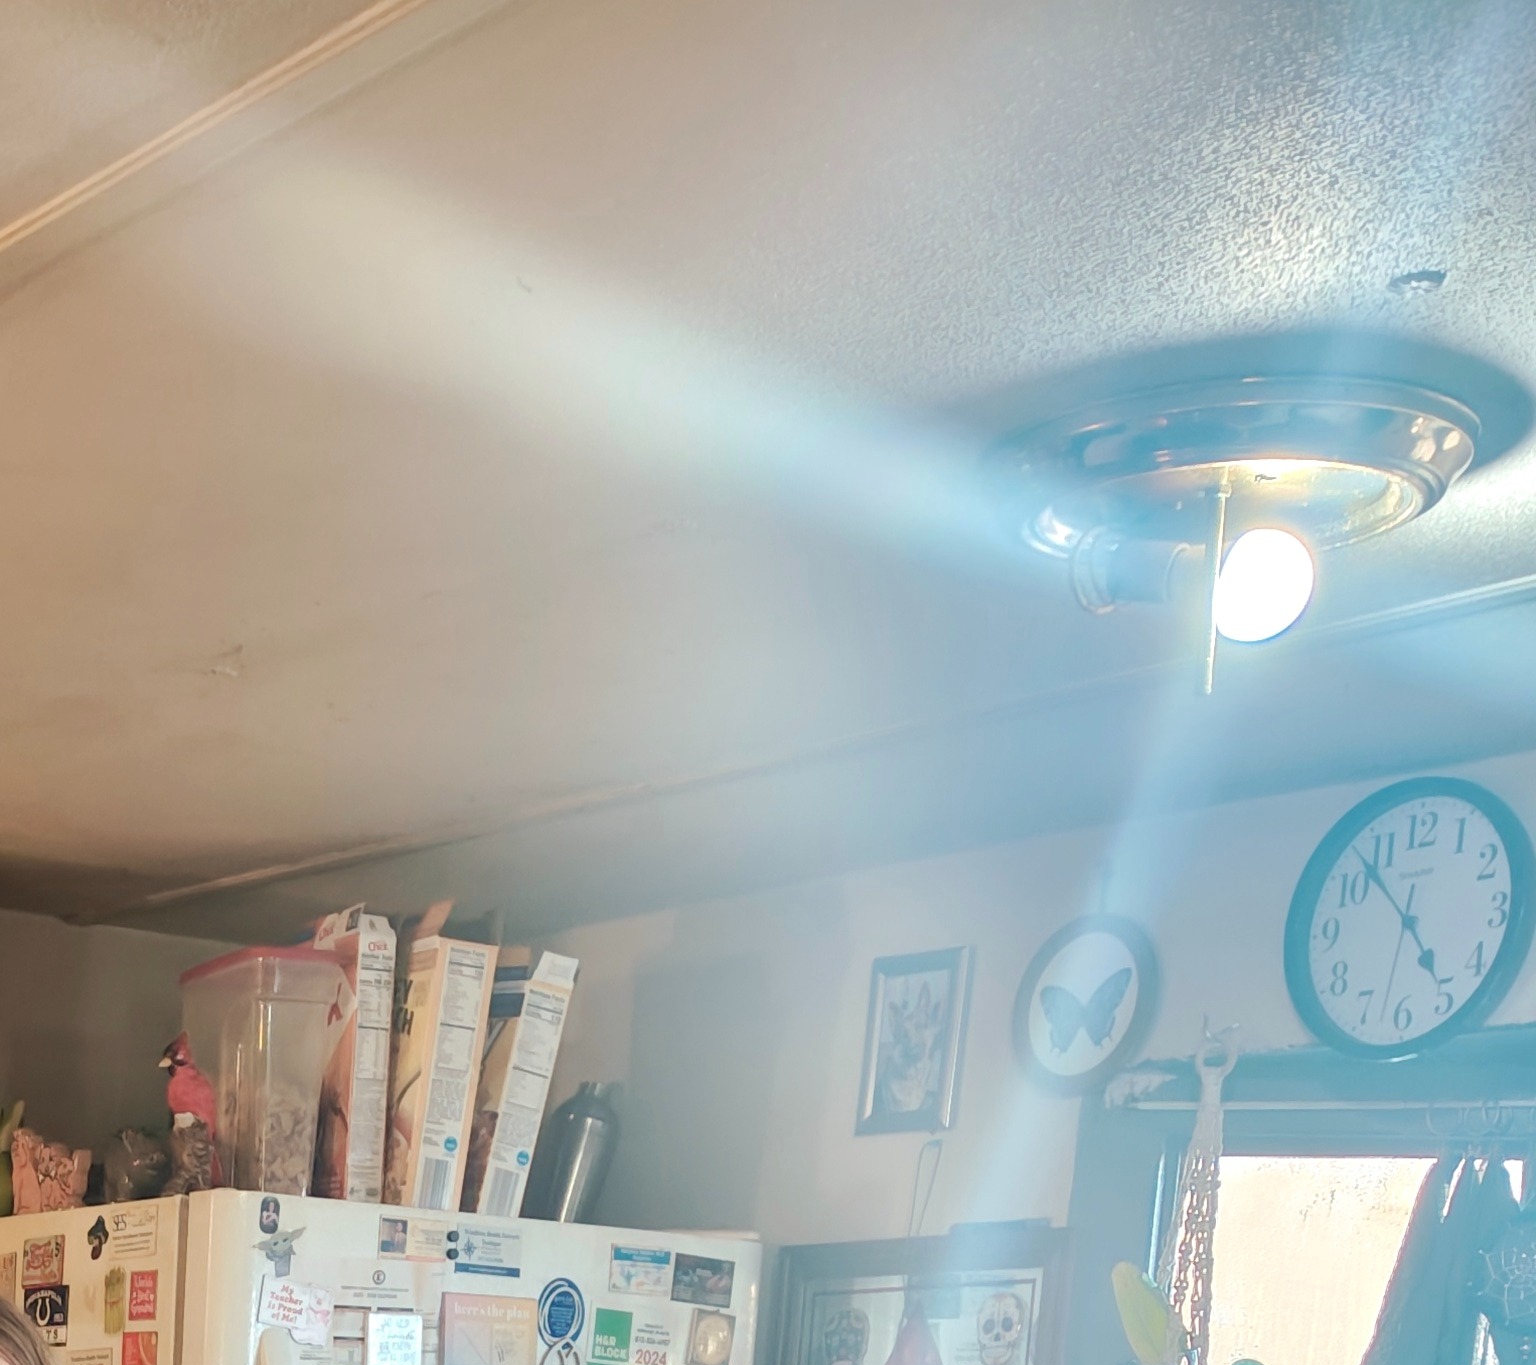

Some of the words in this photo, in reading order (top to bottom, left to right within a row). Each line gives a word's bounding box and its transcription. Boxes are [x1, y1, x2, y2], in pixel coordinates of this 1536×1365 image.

[1405, 811, 1439, 851] 12
[1453, 817, 1467, 855] 1
[1371, 832, 1396, 872] 11
[1476, 843, 1499, 881] 2
[1337, 870, 1370, 909] 10
[1487, 890, 1509, 929] 3
[1321, 917, 1341, 953] 9
[1464, 940, 1487, 978] 4
[1329, 960, 1349, 998] 8
[1433, 975, 1455, 1016] 5
[1357, 989, 1375, 1026] 7
[1393, 994, 1413, 1031] 6
[454, 1301, 486, 1316] here's
[487, 1303, 505, 1318] the
[506, 1304, 531, 1322] plan
[594, 1345, 627, 1360] BLOCK
[595, 1334, 617, 1347] H&R
